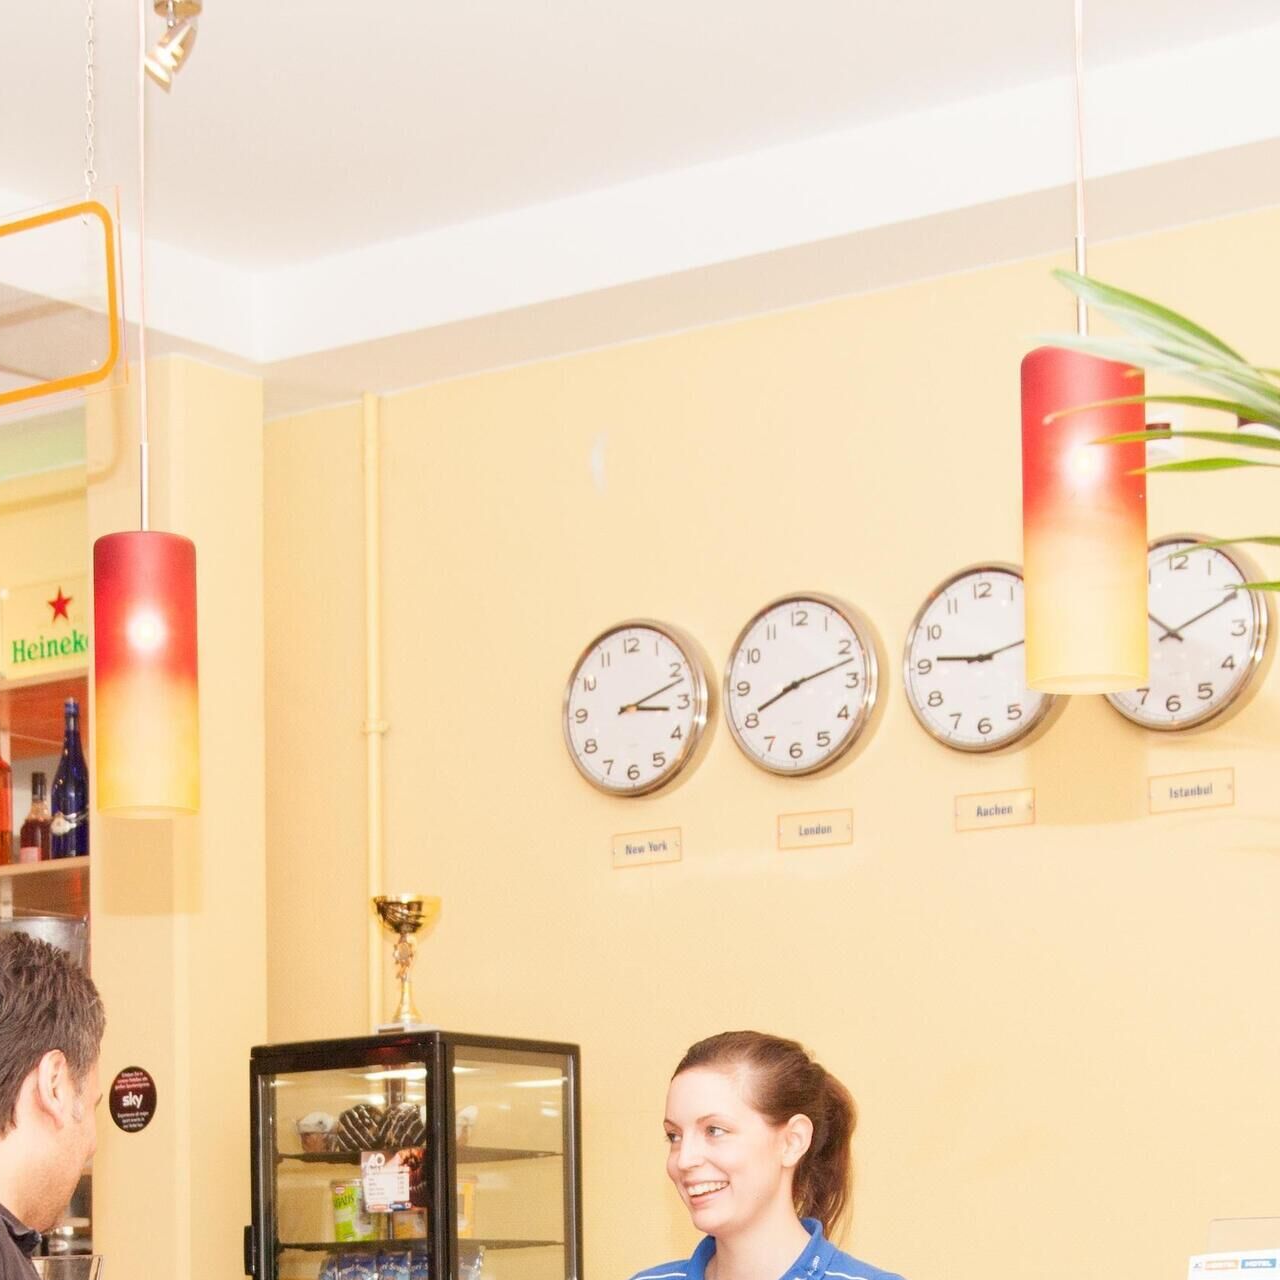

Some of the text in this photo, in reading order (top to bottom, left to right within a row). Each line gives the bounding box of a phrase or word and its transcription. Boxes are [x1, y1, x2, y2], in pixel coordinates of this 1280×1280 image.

[1169, 554, 1189, 571] 12
[973, 582, 993, 599] 12
[947, 597, 958, 614] 11
[791, 610, 809, 627] 12
[766, 624, 776, 640] 11
[927, 624, 942, 641] 10
[1231, 619, 1247, 636] 3
[12, 629, 88, 664] Heinek
[623, 638, 640, 654] 12
[838, 639, 852, 655] 2
[601, 653, 611, 668] 11
[747, 648, 761, 664] 10
[1221, 655, 1235, 670] 4
[669, 662, 682, 678] 2
[917, 659, 933, 675] 9
[845, 672, 859, 689] 3
[736, 681, 751, 697] 9
[1136, 687, 1150, 705] 7
[1197, 682, 1214, 700] 5
[677, 694, 690, 710] 3
[927, 691, 944, 707] 8
[1166, 694, 1182, 712] 6
[575, 709, 588, 724] 9
[837, 705, 850, 720] 4
[1007, 704, 1023, 720] 5
[744, 713, 760, 729] 8
[949, 713, 962, 730] 7
[977, 718, 993, 735] 6
[670, 725, 682, 740] 4
[816, 731, 831, 747] 5
[584, 738, 598, 754] 8
[763, 735, 776, 752] 7
[789, 742, 803, 759] 6
[602, 759, 614, 776] 7
[652, 752, 666, 768] 5
[627, 764, 641, 780] 6
[1169, 783, 1213, 799] Istanbul
[976, 805, 1013, 817] Aachen
[798, 824, 832, 837] London
[625, 841, 668, 855] New York
[122, 1091, 143, 1109] sky
